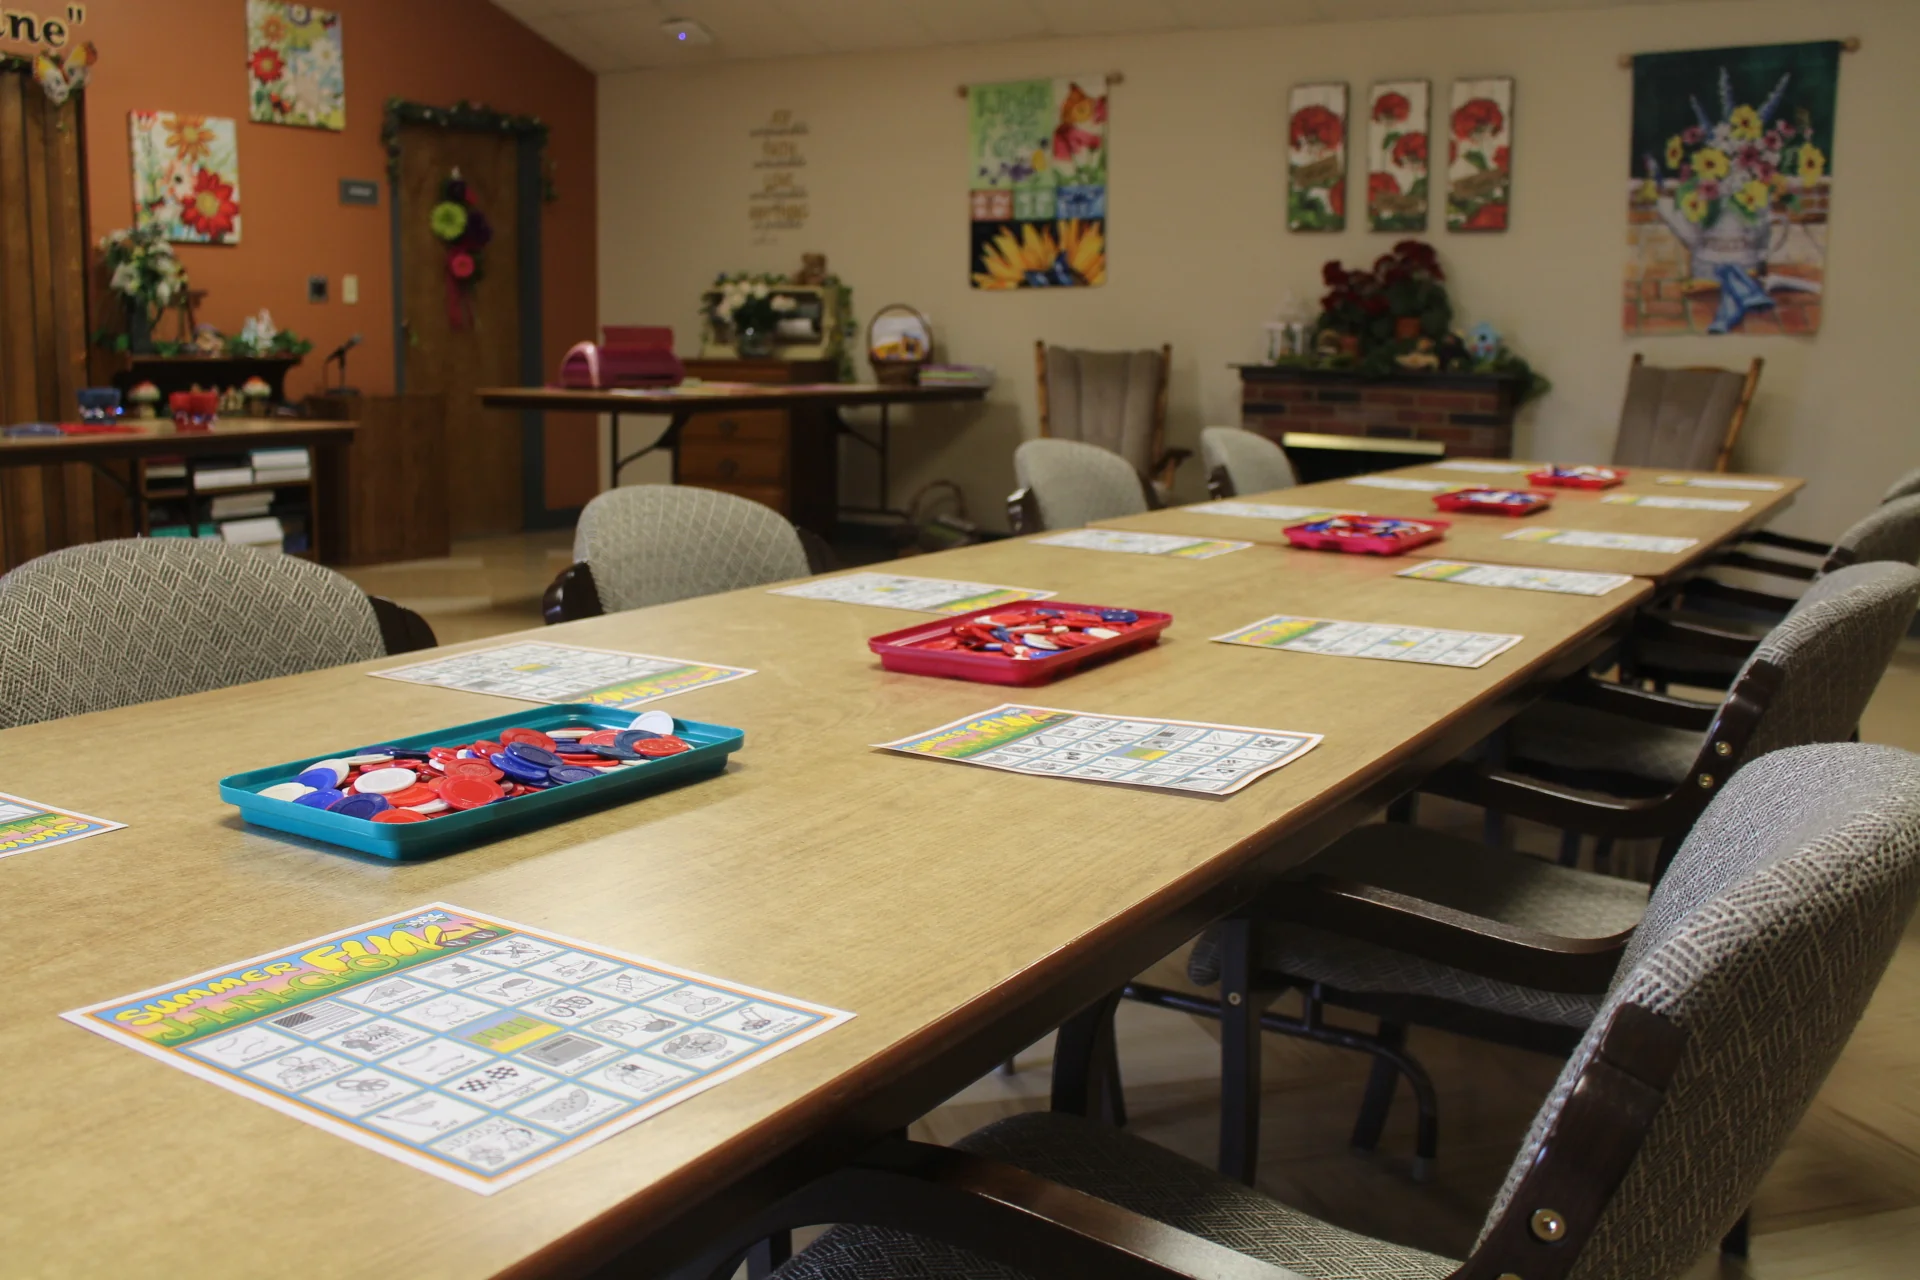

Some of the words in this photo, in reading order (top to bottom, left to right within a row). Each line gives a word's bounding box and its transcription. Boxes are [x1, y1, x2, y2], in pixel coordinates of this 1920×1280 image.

[0, 7, 82, 48] ne"
[115, 962, 301, 1026] SUMMER
[299, 924, 447, 973] FUN
[453, 970, 494, 984] Australia
[160, 953, 399, 1041] J-I-N-G-O
[468, 1016, 543, 1046] FREE
